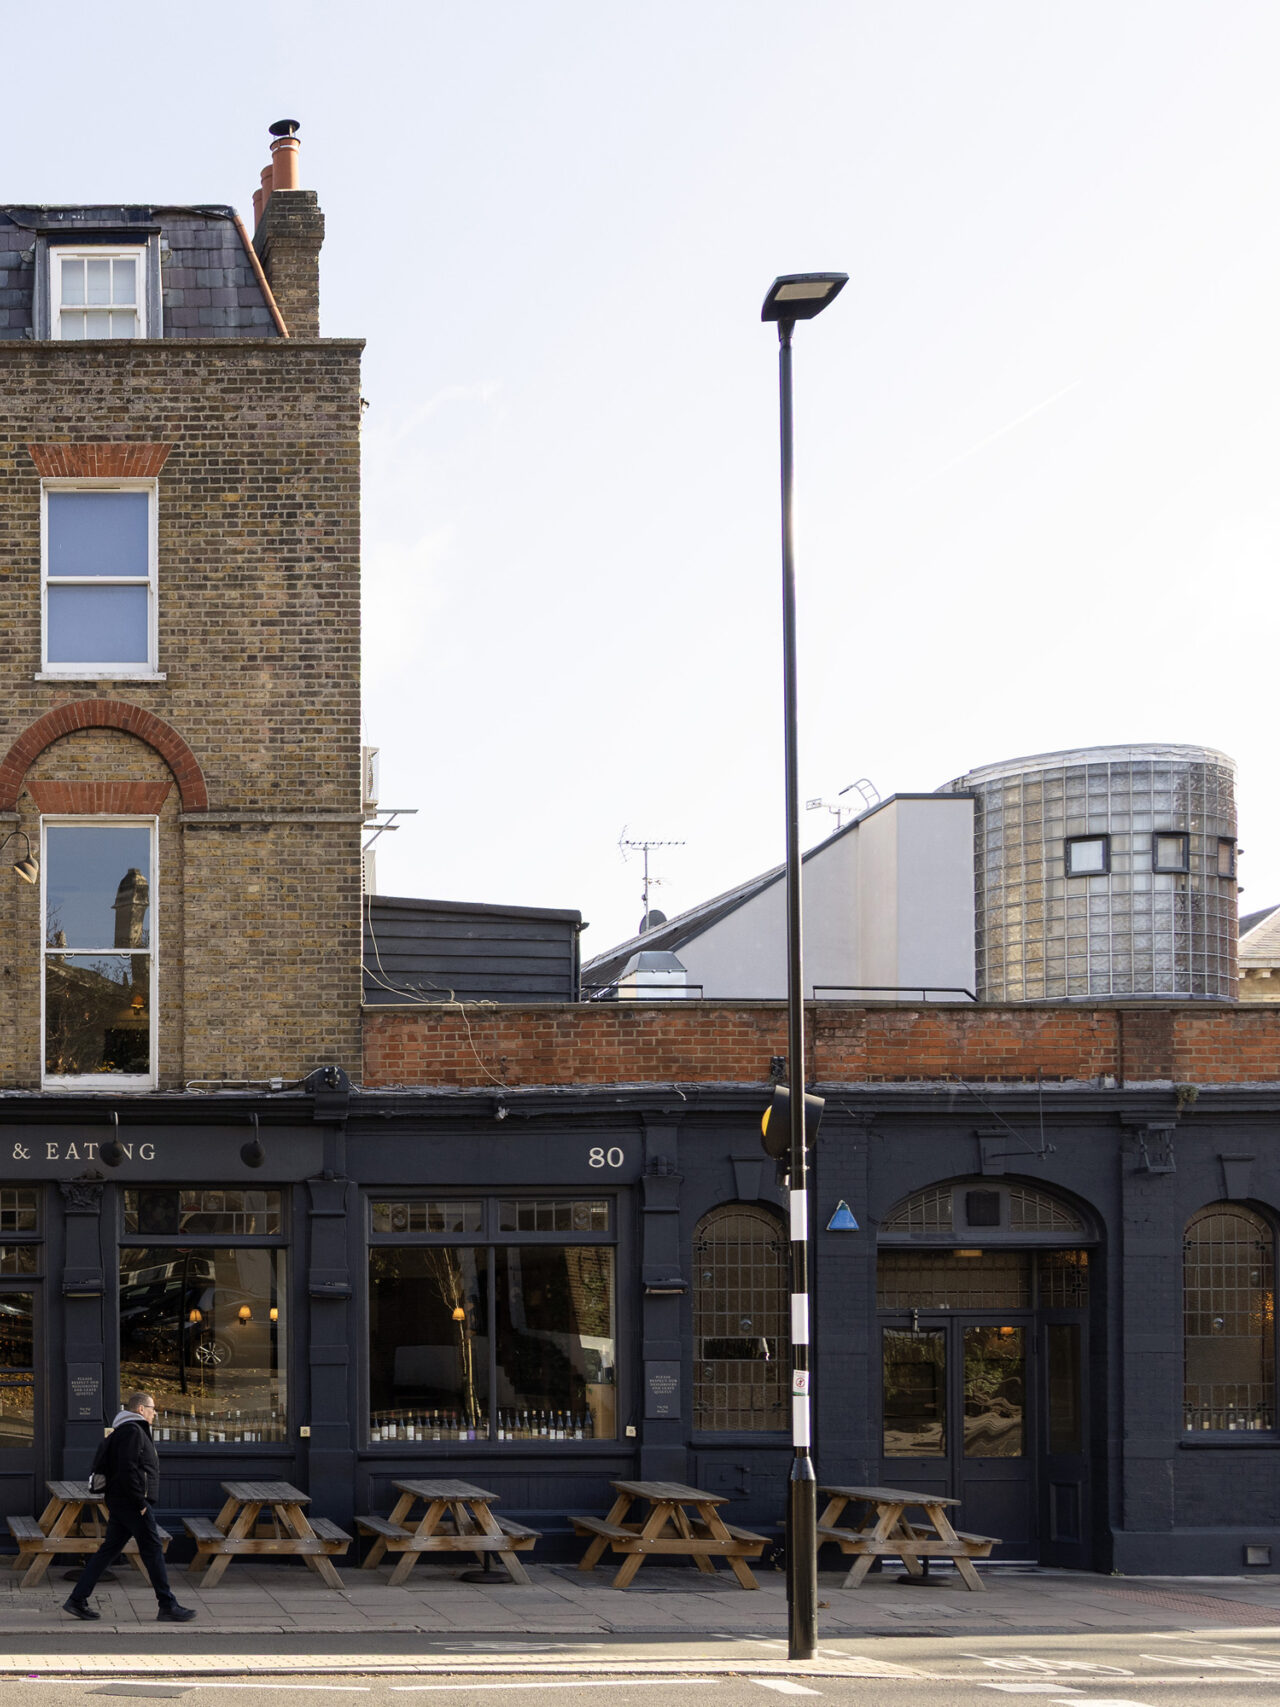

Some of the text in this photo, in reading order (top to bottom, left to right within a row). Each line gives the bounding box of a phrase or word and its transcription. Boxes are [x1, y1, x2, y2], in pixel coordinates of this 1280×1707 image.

[12, 1143, 31, 1160] &
[46, 1143, 156, 1160] EATNG
[588, 1147, 624, 1168] 80
